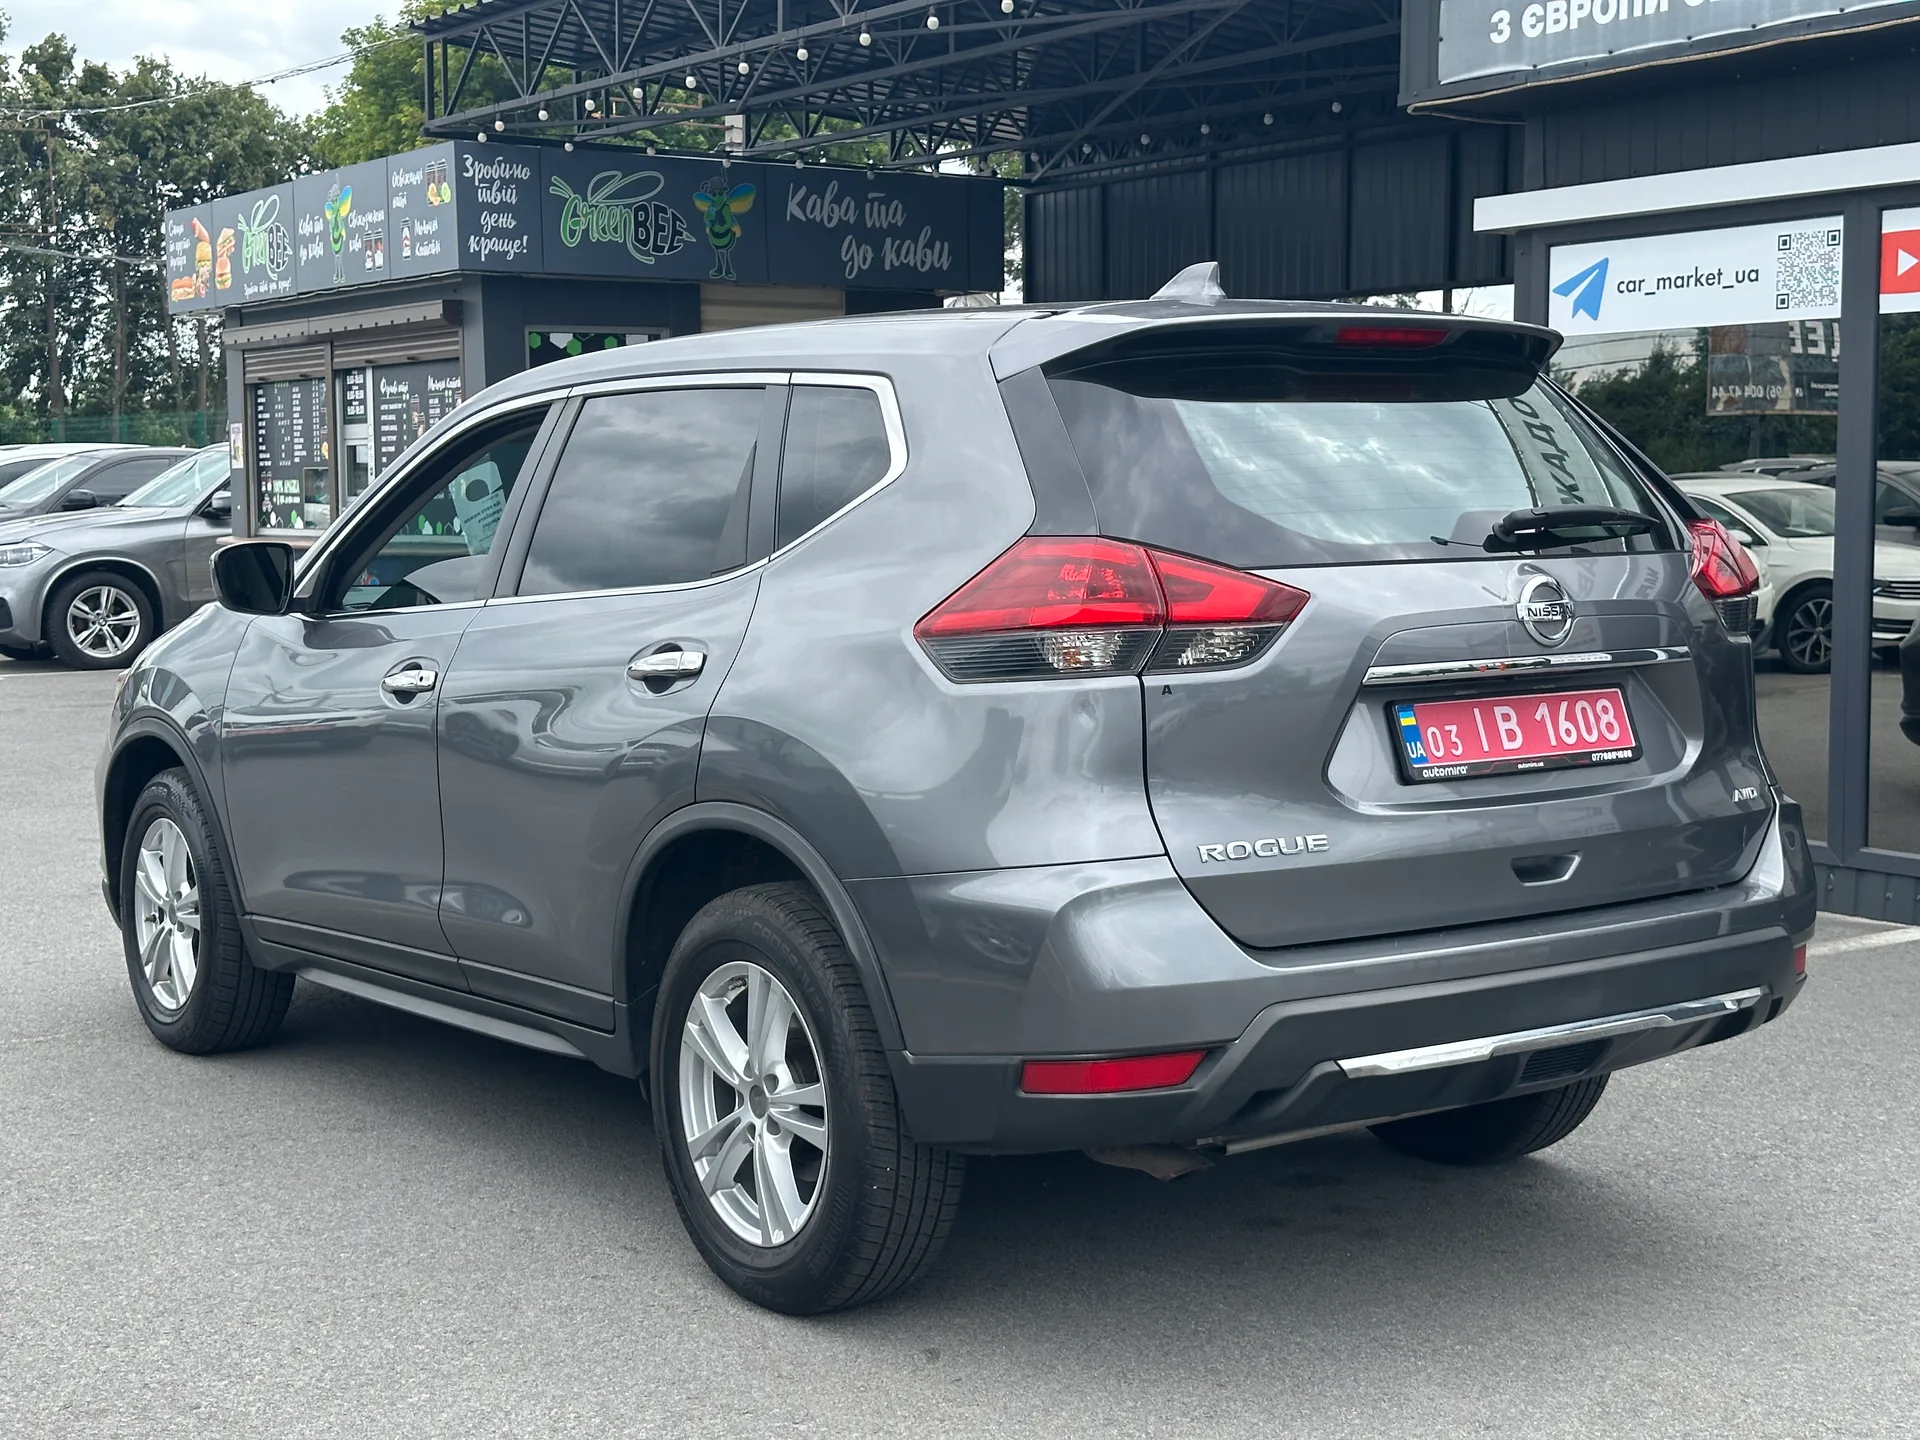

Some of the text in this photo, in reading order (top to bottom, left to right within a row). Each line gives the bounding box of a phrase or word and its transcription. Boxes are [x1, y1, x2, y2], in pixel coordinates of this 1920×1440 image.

[463, 154, 531, 186] Зробимо
[477, 180, 518, 205] твій
[787, 180, 907, 229] Кава та
[480, 211, 517, 234] день
[468, 235, 528, 262] краще!
[841, 225, 952, 279] до кави
[1617, 266, 1760, 296] car_market_ua
[1527, 604, 1573, 618] NISSAN
[1406, 741, 1426, 758] UA
[1426, 724, 1463, 758] 03
[1534, 699, 1621, 747] 1608
[1423, 766, 1468, 778] automira
[1197, 833, 1330, 863] ROGUE
